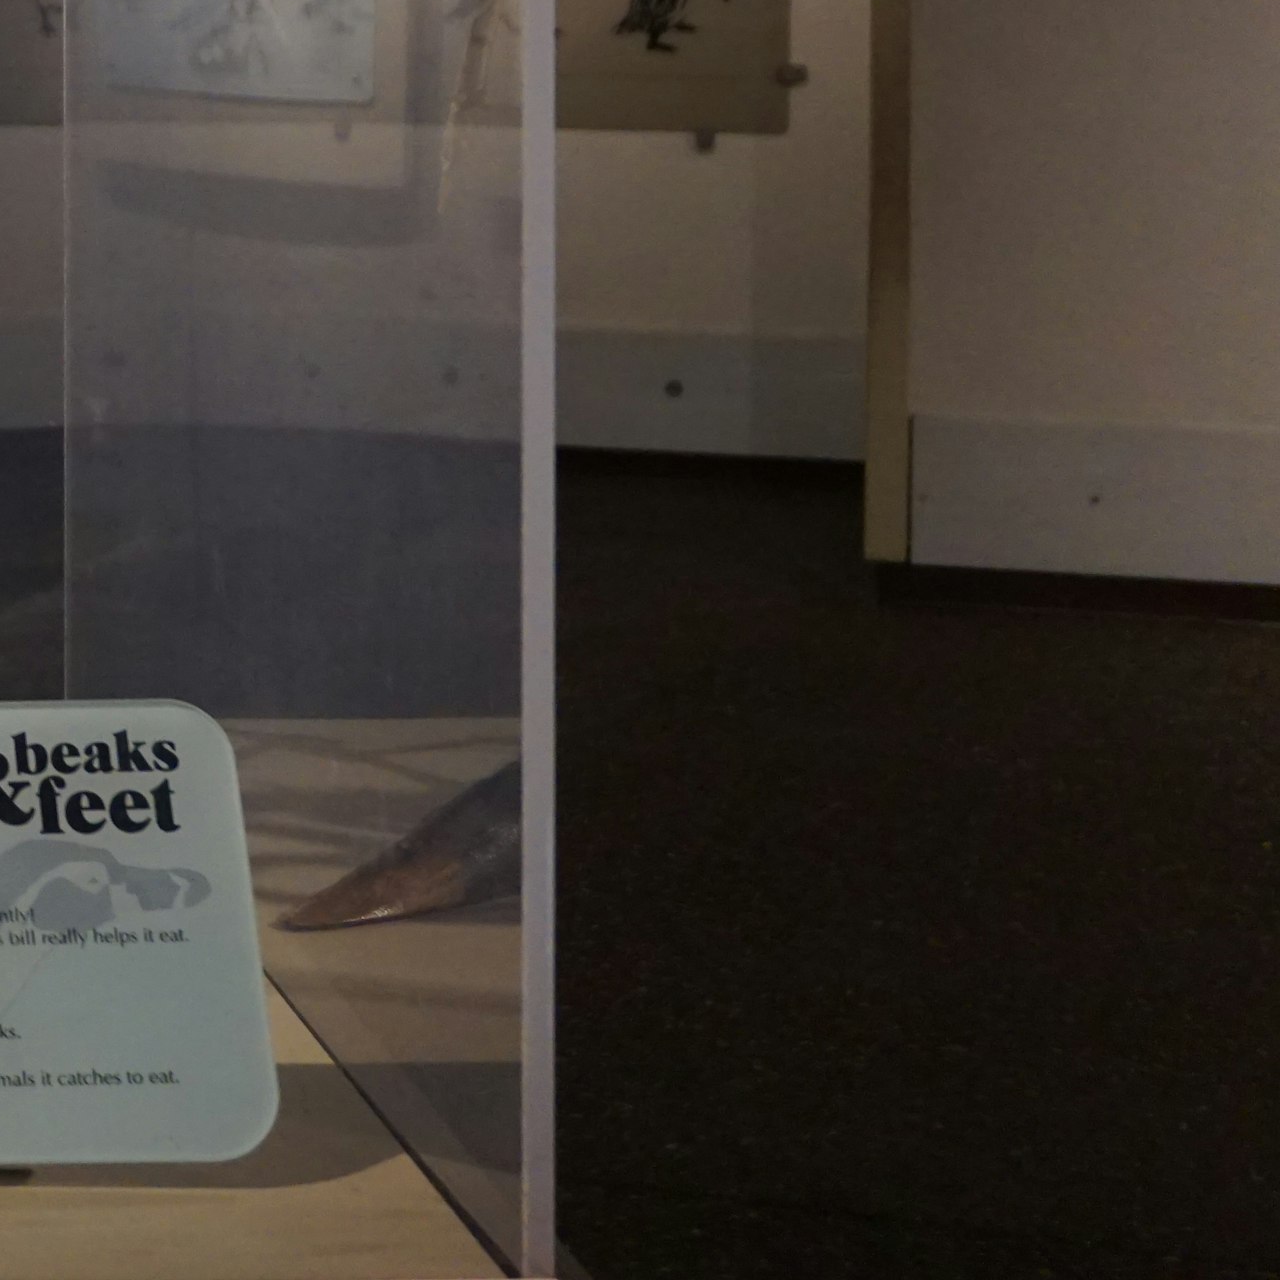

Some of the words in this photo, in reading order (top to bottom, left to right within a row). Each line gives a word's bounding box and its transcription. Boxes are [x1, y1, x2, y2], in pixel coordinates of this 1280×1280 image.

[11, 728, 181, 775] beaks
[36, 775, 182, 834] feet
[9, 927, 36, 946] bill
[41, 927, 87, 948] really
[92, 926, 138, 947] helps
[143, 926, 156, 942] it
[41, 1071, 53, 1087] it
[57, 1070, 122, 1086] catches
[127, 1071, 143, 1085] to
[148, 1070, 180, 1085] eat.
